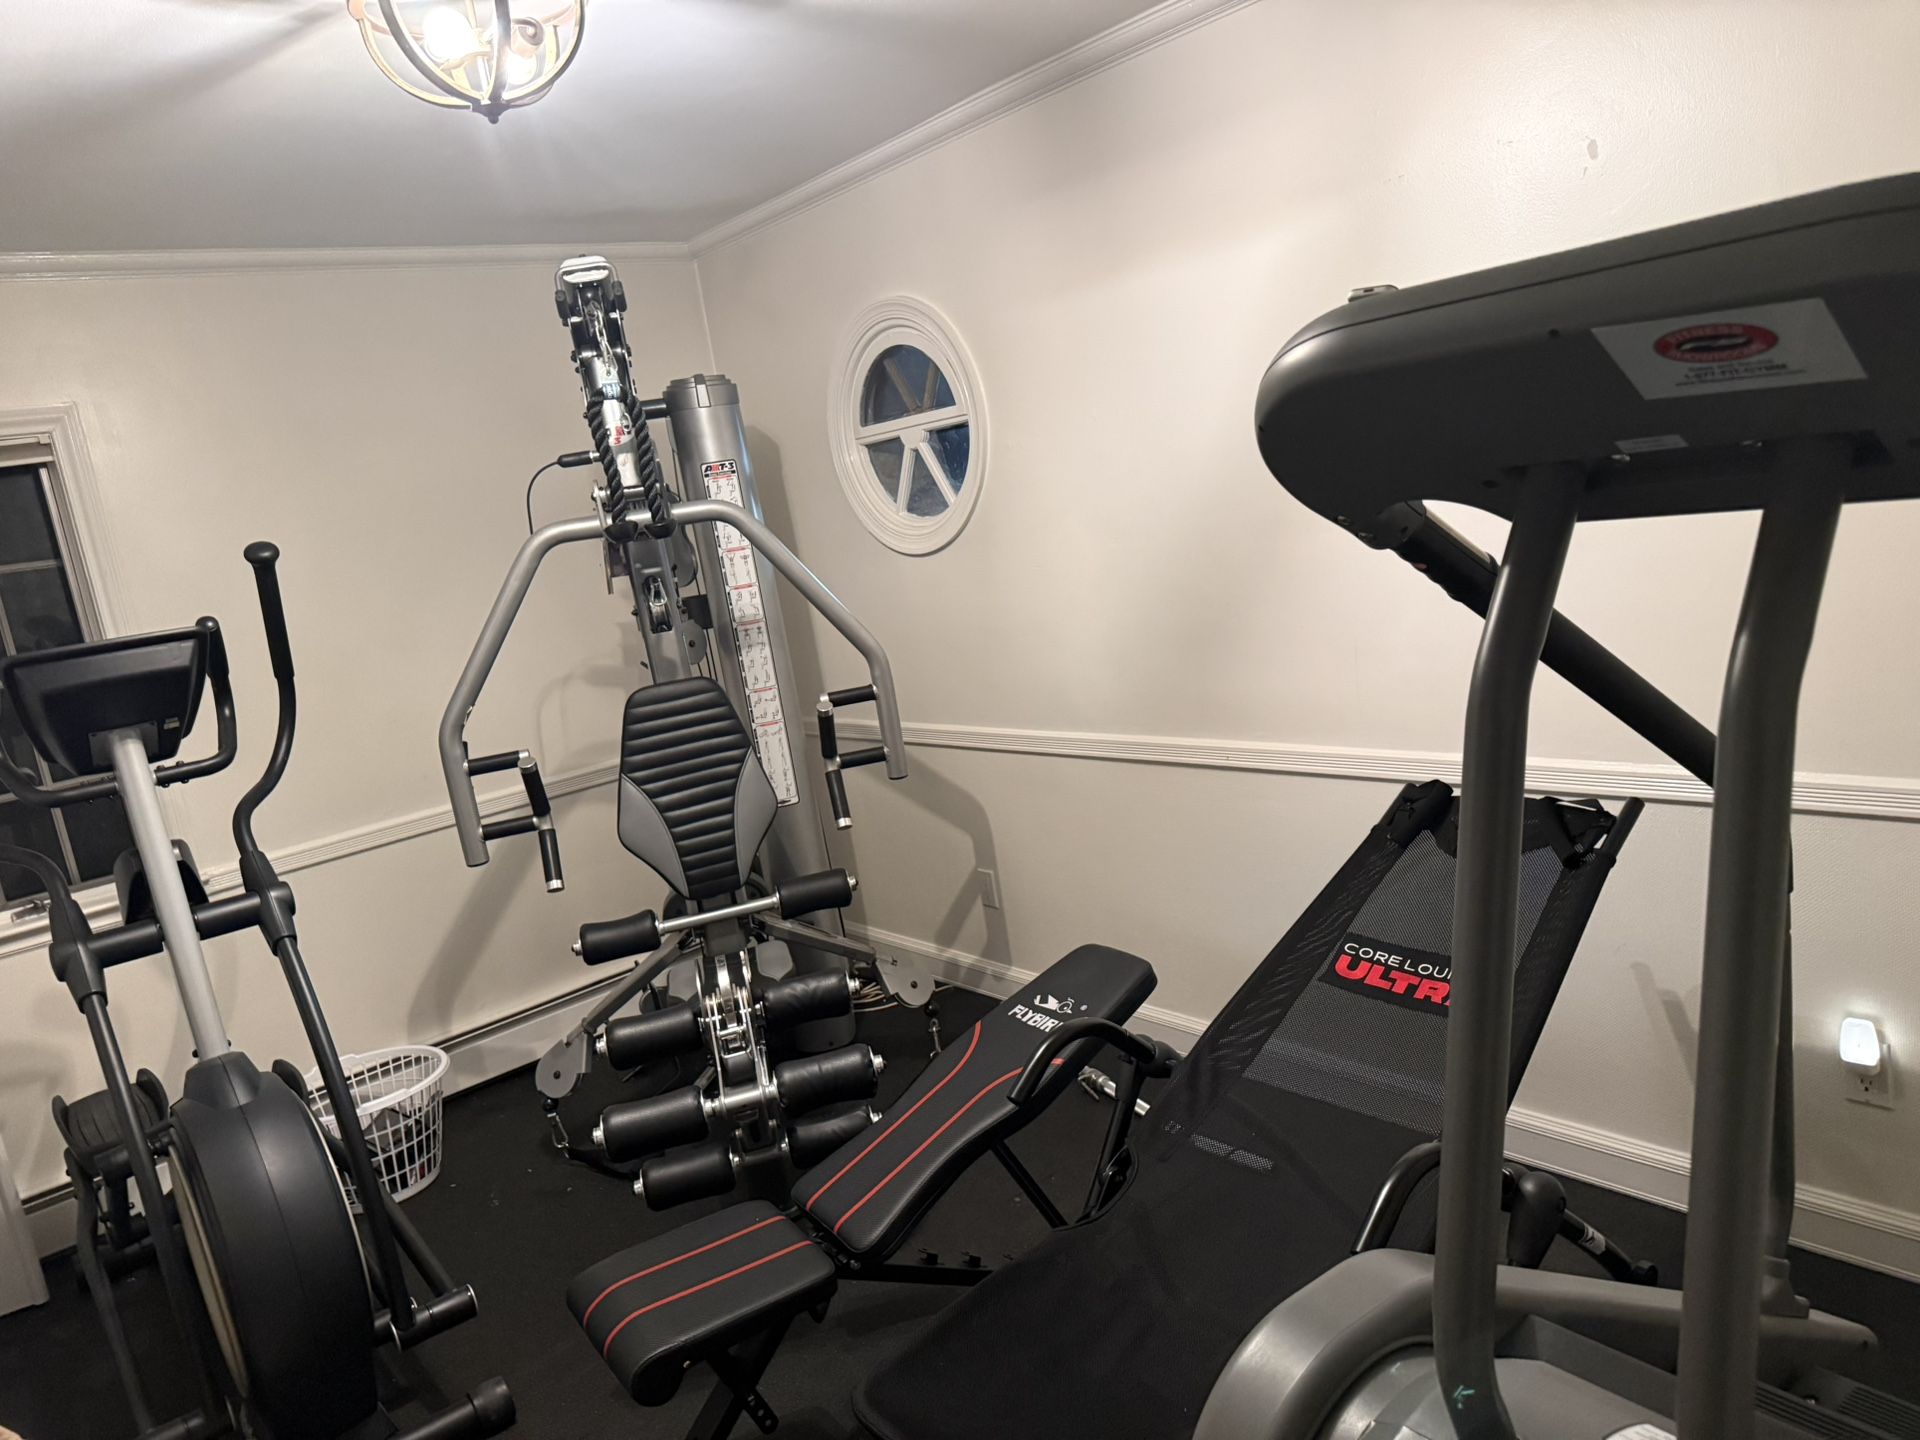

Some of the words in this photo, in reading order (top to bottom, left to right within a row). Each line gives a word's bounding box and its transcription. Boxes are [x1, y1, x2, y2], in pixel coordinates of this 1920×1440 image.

[1344, 942, 1402, 967] CORE
[1334, 953, 1451, 1007] ULTR
[1007, 1003, 1064, 1033] FLYBIR
